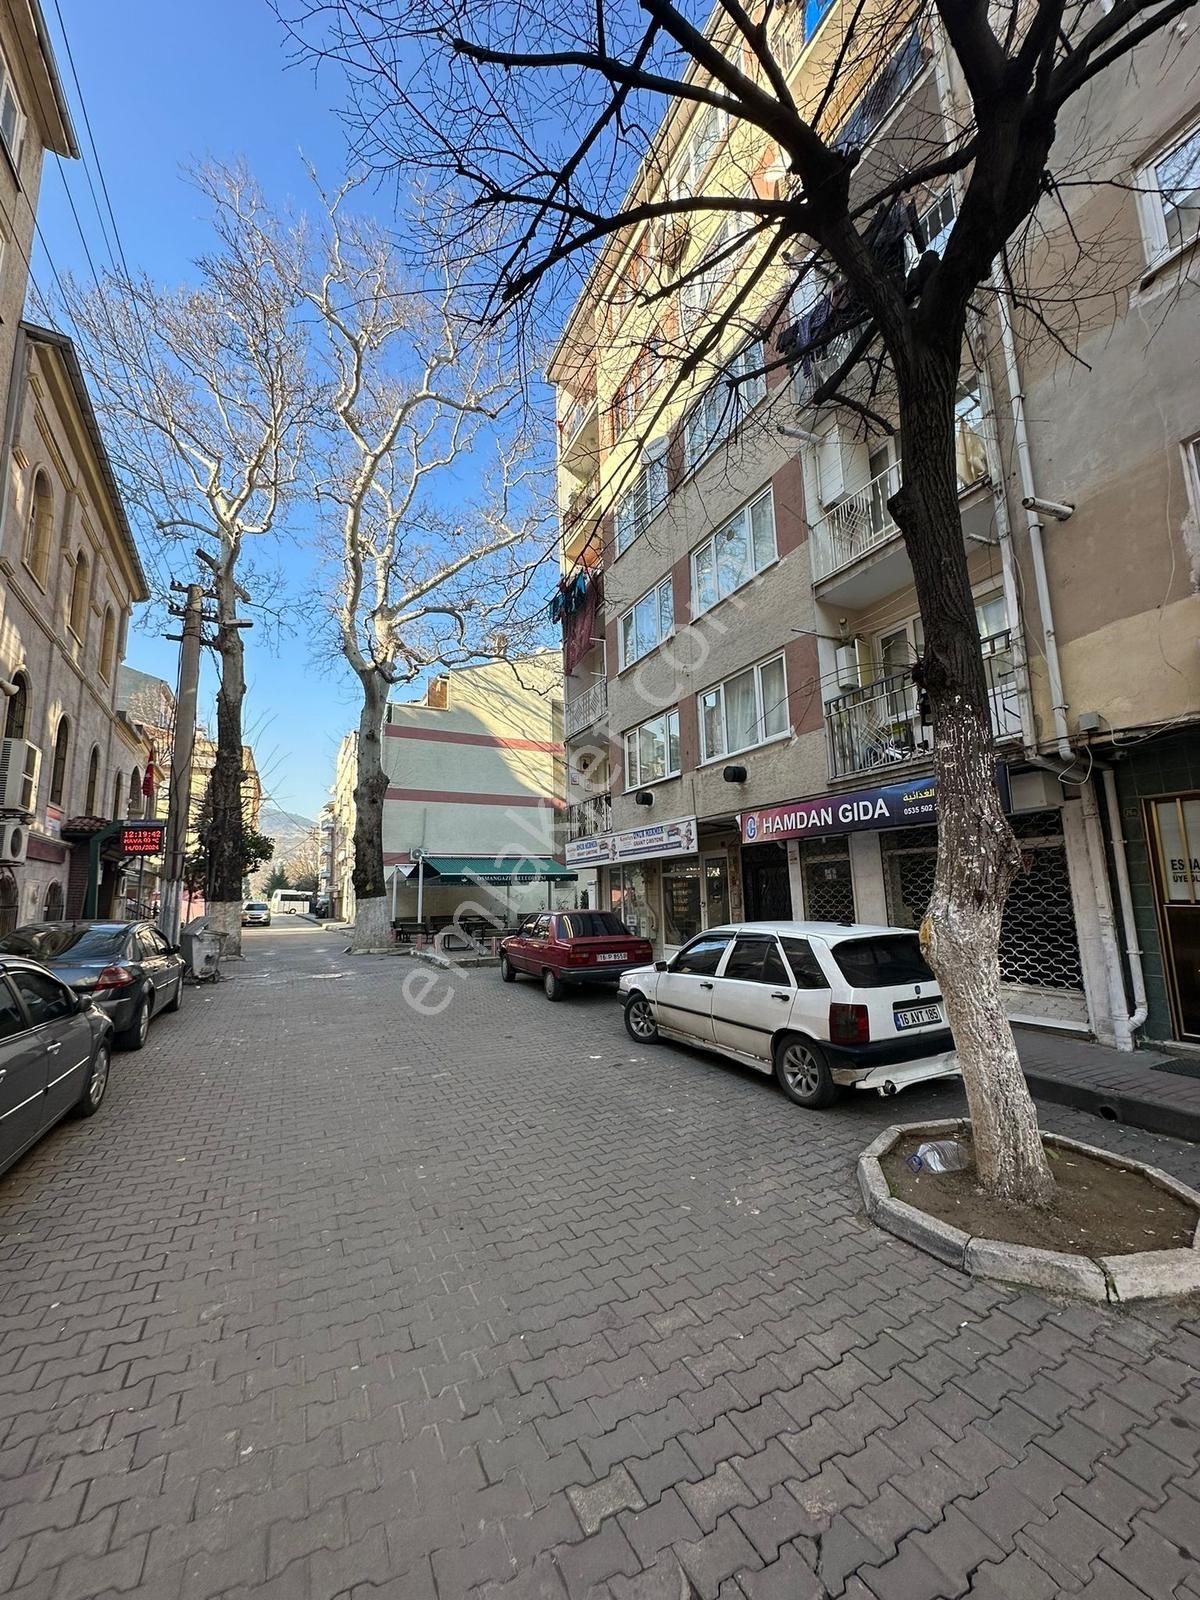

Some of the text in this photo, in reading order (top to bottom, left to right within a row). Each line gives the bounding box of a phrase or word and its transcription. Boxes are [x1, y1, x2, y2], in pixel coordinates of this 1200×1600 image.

[762, 798, 890, 834] HAMDAN GIDA
[904, 806, 920, 815] 0535
[920, 804, 933, 813] 502
[900, 1008, 939, 1025] 16 AVT 185
